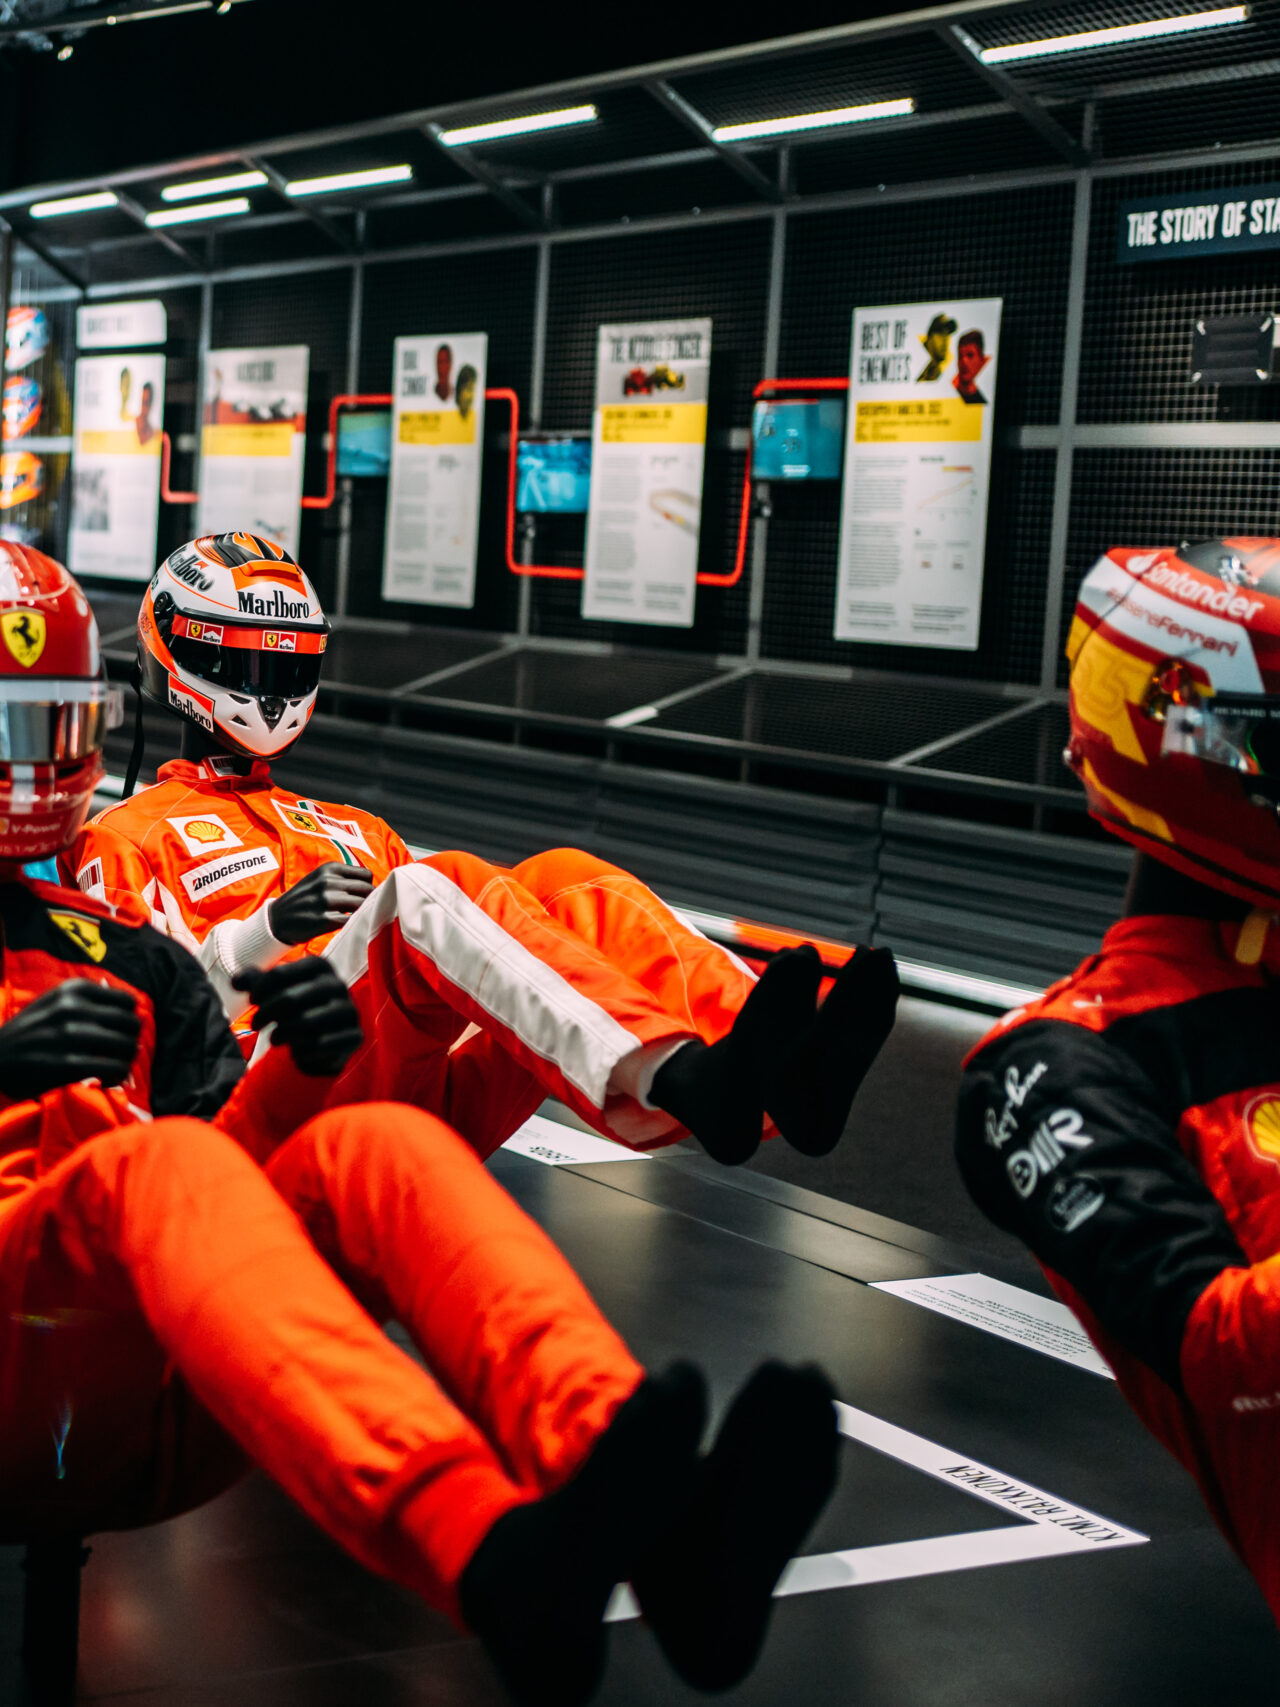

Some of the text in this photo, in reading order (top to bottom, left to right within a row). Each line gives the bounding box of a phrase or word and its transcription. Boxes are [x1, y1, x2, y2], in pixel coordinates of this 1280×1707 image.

[1127, 211, 1158, 247] THE
[1159, 204, 1219, 245] STORY
[1221, 201, 1247, 238] OF
[862, 319, 908, 351] BEST OF
[859, 353, 911, 384] ENEMIES
[236, 590, 310, 619] Marlboro
[170, 689, 212, 730] Marlboro
[192, 854, 268, 892] BRIDGESTONE
[1048, 1513, 1125, 1543] KIMI
